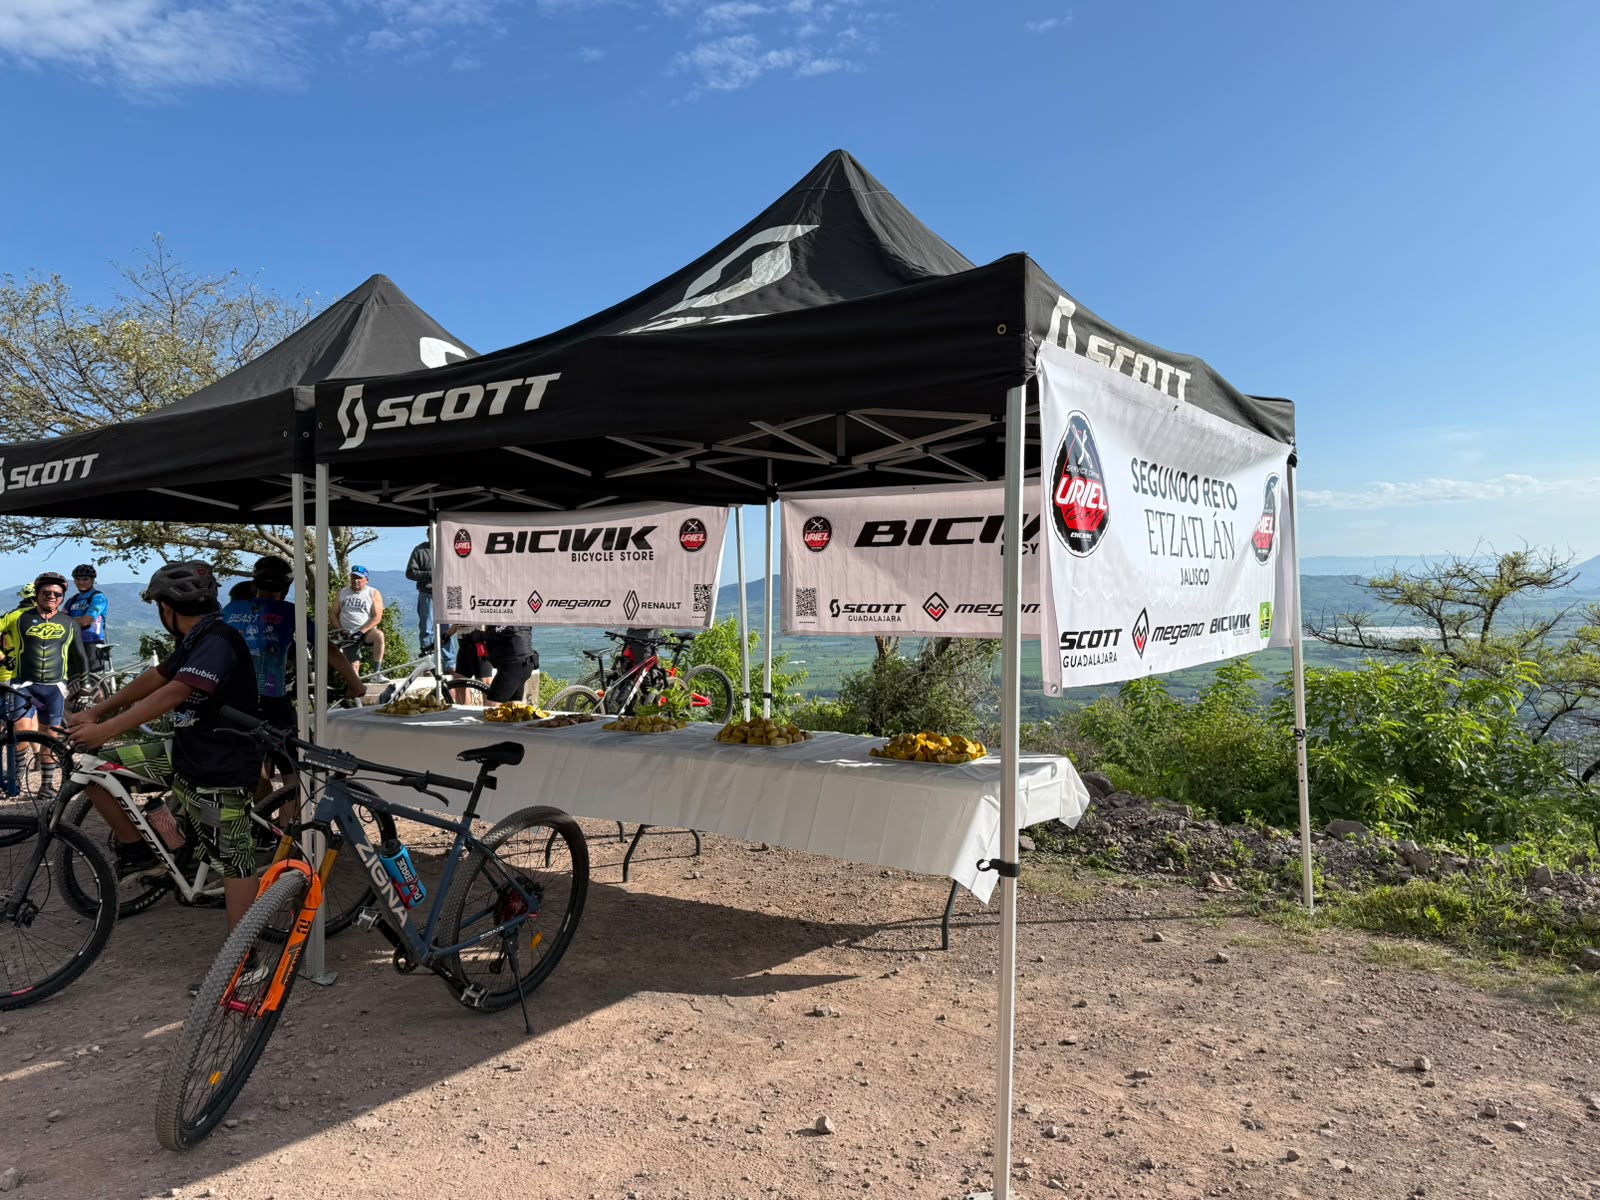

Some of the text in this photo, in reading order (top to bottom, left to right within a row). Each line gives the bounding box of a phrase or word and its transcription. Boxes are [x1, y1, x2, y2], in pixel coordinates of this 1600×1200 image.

[372, 372, 562, 430] SCOTT
[7, 453, 99, 490] SCOTT
[1056, 477, 1108, 510] URIEL
[1131, 457, 1238, 511] SEGUNDO RETO
[484, 525, 659, 555] BICIVIK
[681, 533, 706, 542] URIEL
[805, 532, 830, 542] URIEL
[1144, 510, 1236, 560] ETZATLÁN
[571, 551, 654, 562] BICYCLE STORE
[1180, 568, 1210, 586] JALISCO
[477, 599, 517, 607] SCOTT
[546, 599, 611, 610] megamo
[641, 602, 682, 610] RENAULT
[842, 604, 906, 613] SCOTT
[954, 603, 1040, 617] megm
[1209, 613, 1251, 634] BICIVIK
[1060, 628, 1123, 650] SCOTT
[1151, 622, 1205, 645] megamo
[1063, 651, 1118, 668] GUADALAJARA
[355, 835, 409, 929] ZIGNA
